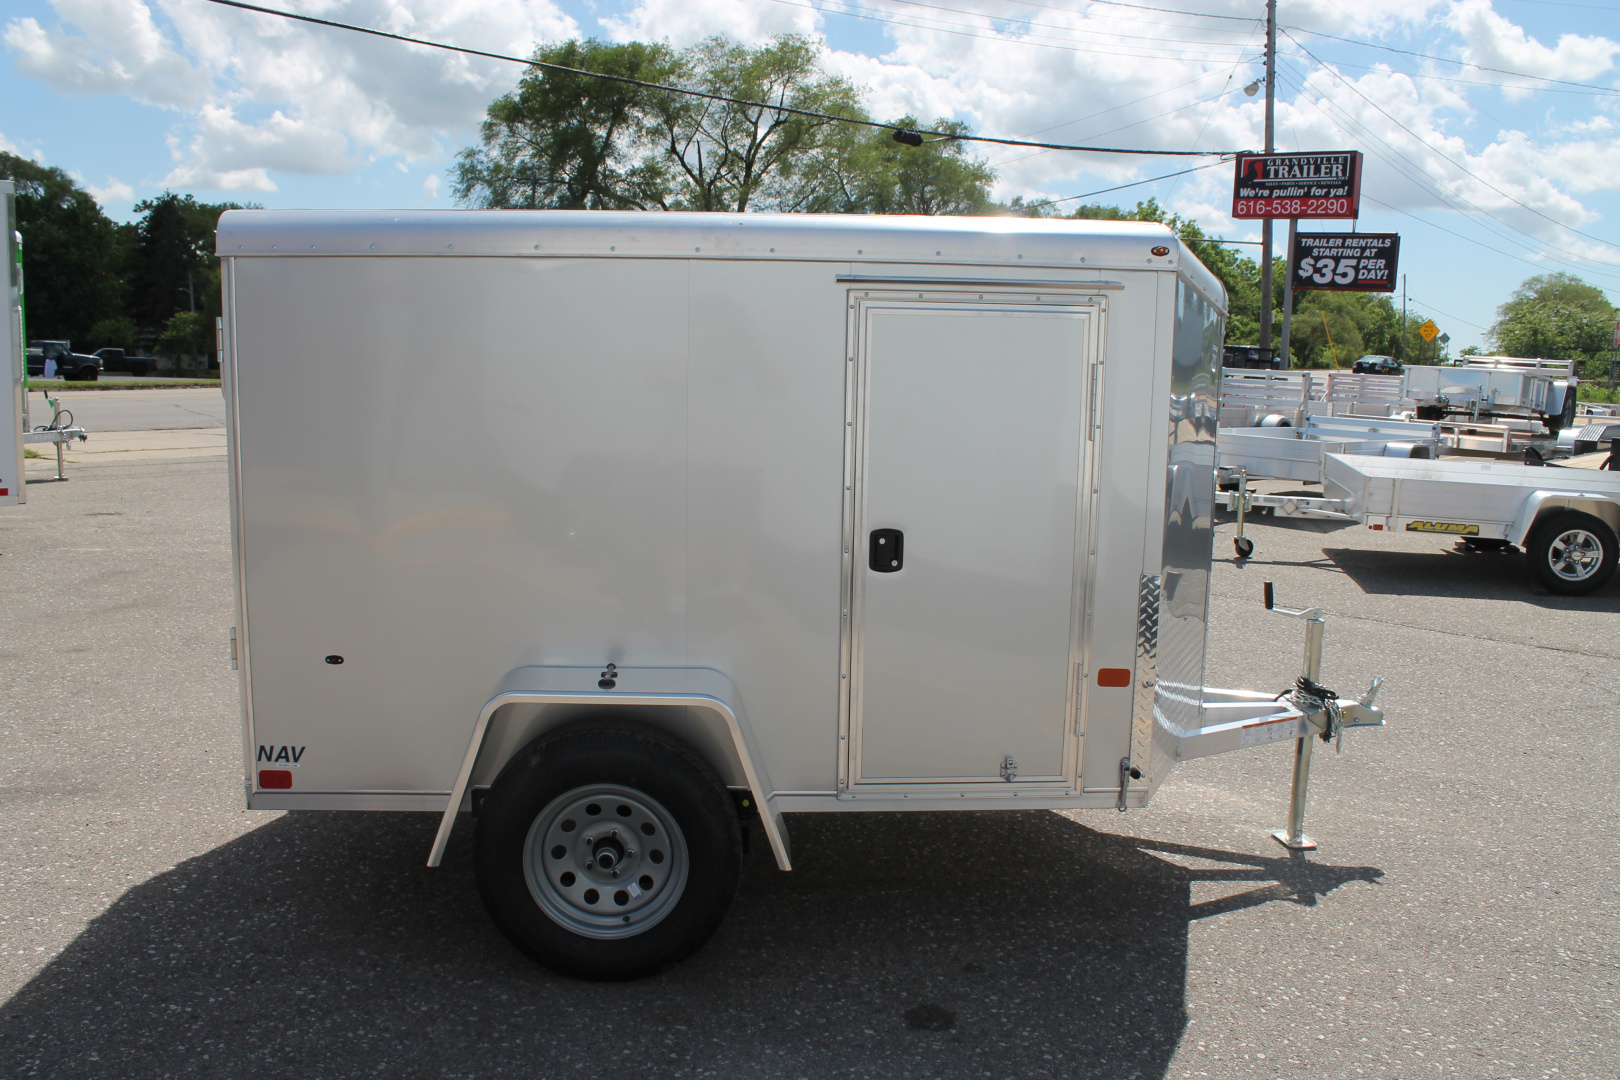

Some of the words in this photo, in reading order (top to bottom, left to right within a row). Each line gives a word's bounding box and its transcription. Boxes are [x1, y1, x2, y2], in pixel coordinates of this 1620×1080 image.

[1267, 157, 1345, 166] GRANDVILLE
[1266, 165, 1343, 179] TRAILER
[1239, 188, 1270, 197] We're
[1272, 187, 1308, 199] pullin'
[1310, 186, 1328, 196] for
[1329, 186, 1349, 197] ya!
[1237, 199, 1347, 215] 616-538-2290
[1301, 238, 1343, 247] TRAILER
[1344, 238, 1392, 247] RENTALS
[1312, 248, 1361, 257] STARTING
[1362, 248, 1378, 257] AT
[1298, 256, 1358, 285] $35
[1359, 259, 1386, 269] PER
[1357, 270, 1389, 280] DAY!
[1408, 521, 1479, 534] ALUMA
[257, 745, 306, 763] NAV
